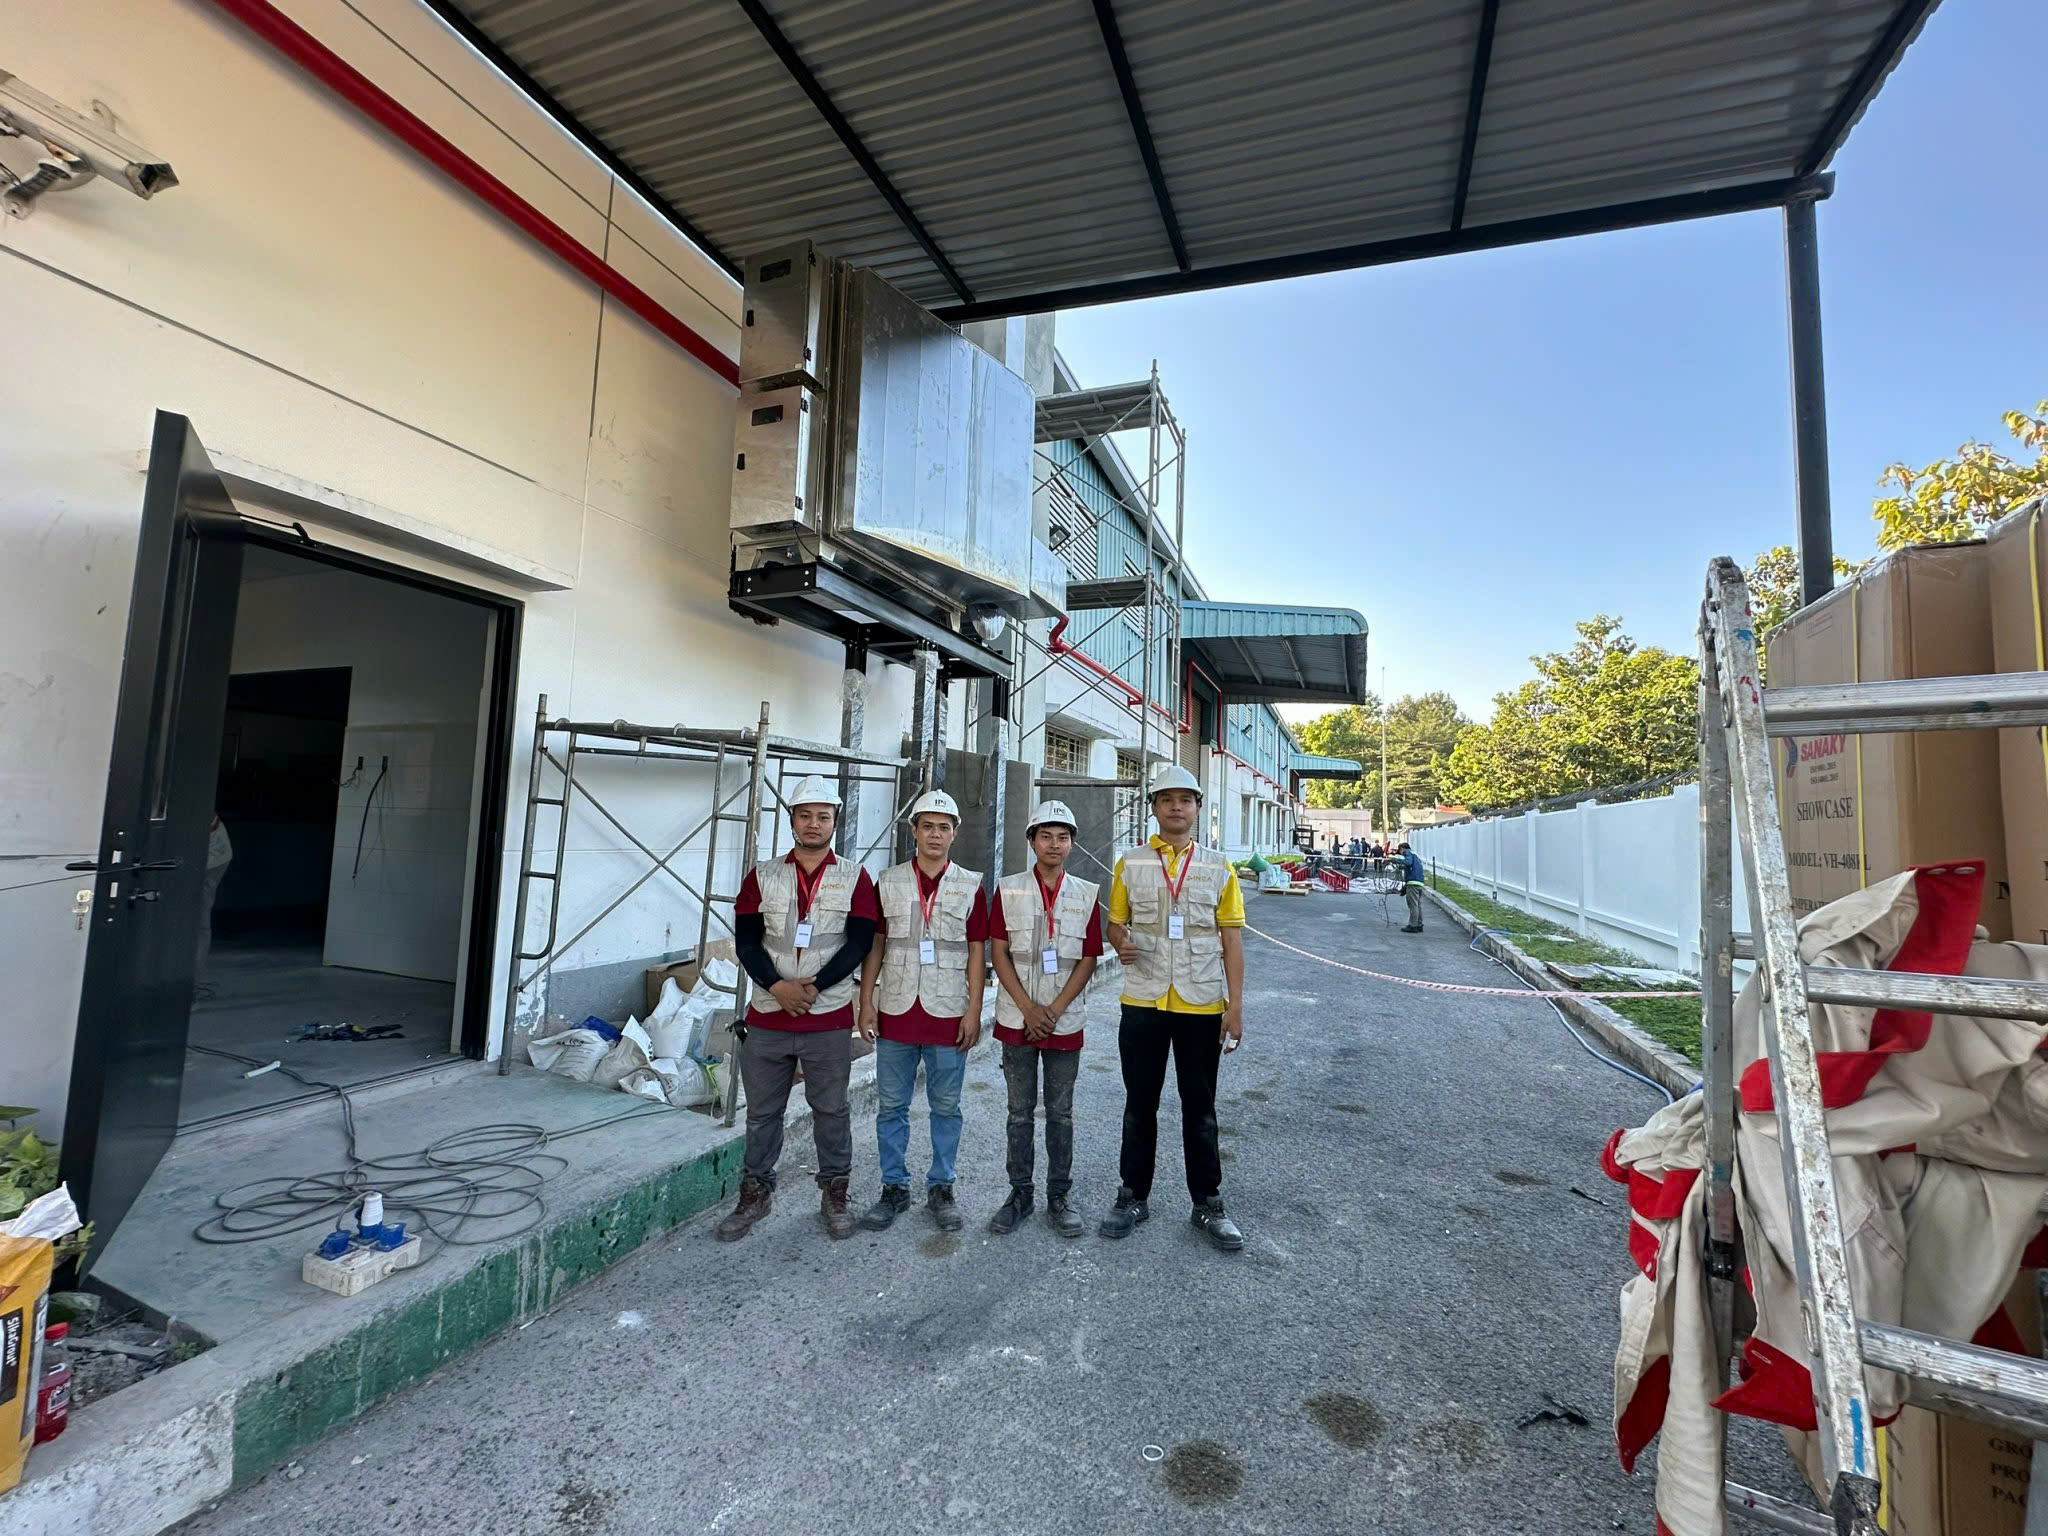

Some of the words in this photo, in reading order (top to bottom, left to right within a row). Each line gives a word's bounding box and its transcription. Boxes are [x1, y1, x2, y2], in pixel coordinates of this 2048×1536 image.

[1801, 734, 1846, 762] SANAKY
[1797, 797, 1853, 821] SHOWCASE
[1788, 852, 1822, 868] MODEL:
[1989, 1437, 2034, 1458] GRO
[1990, 1461, 2031, 1483] PRO
